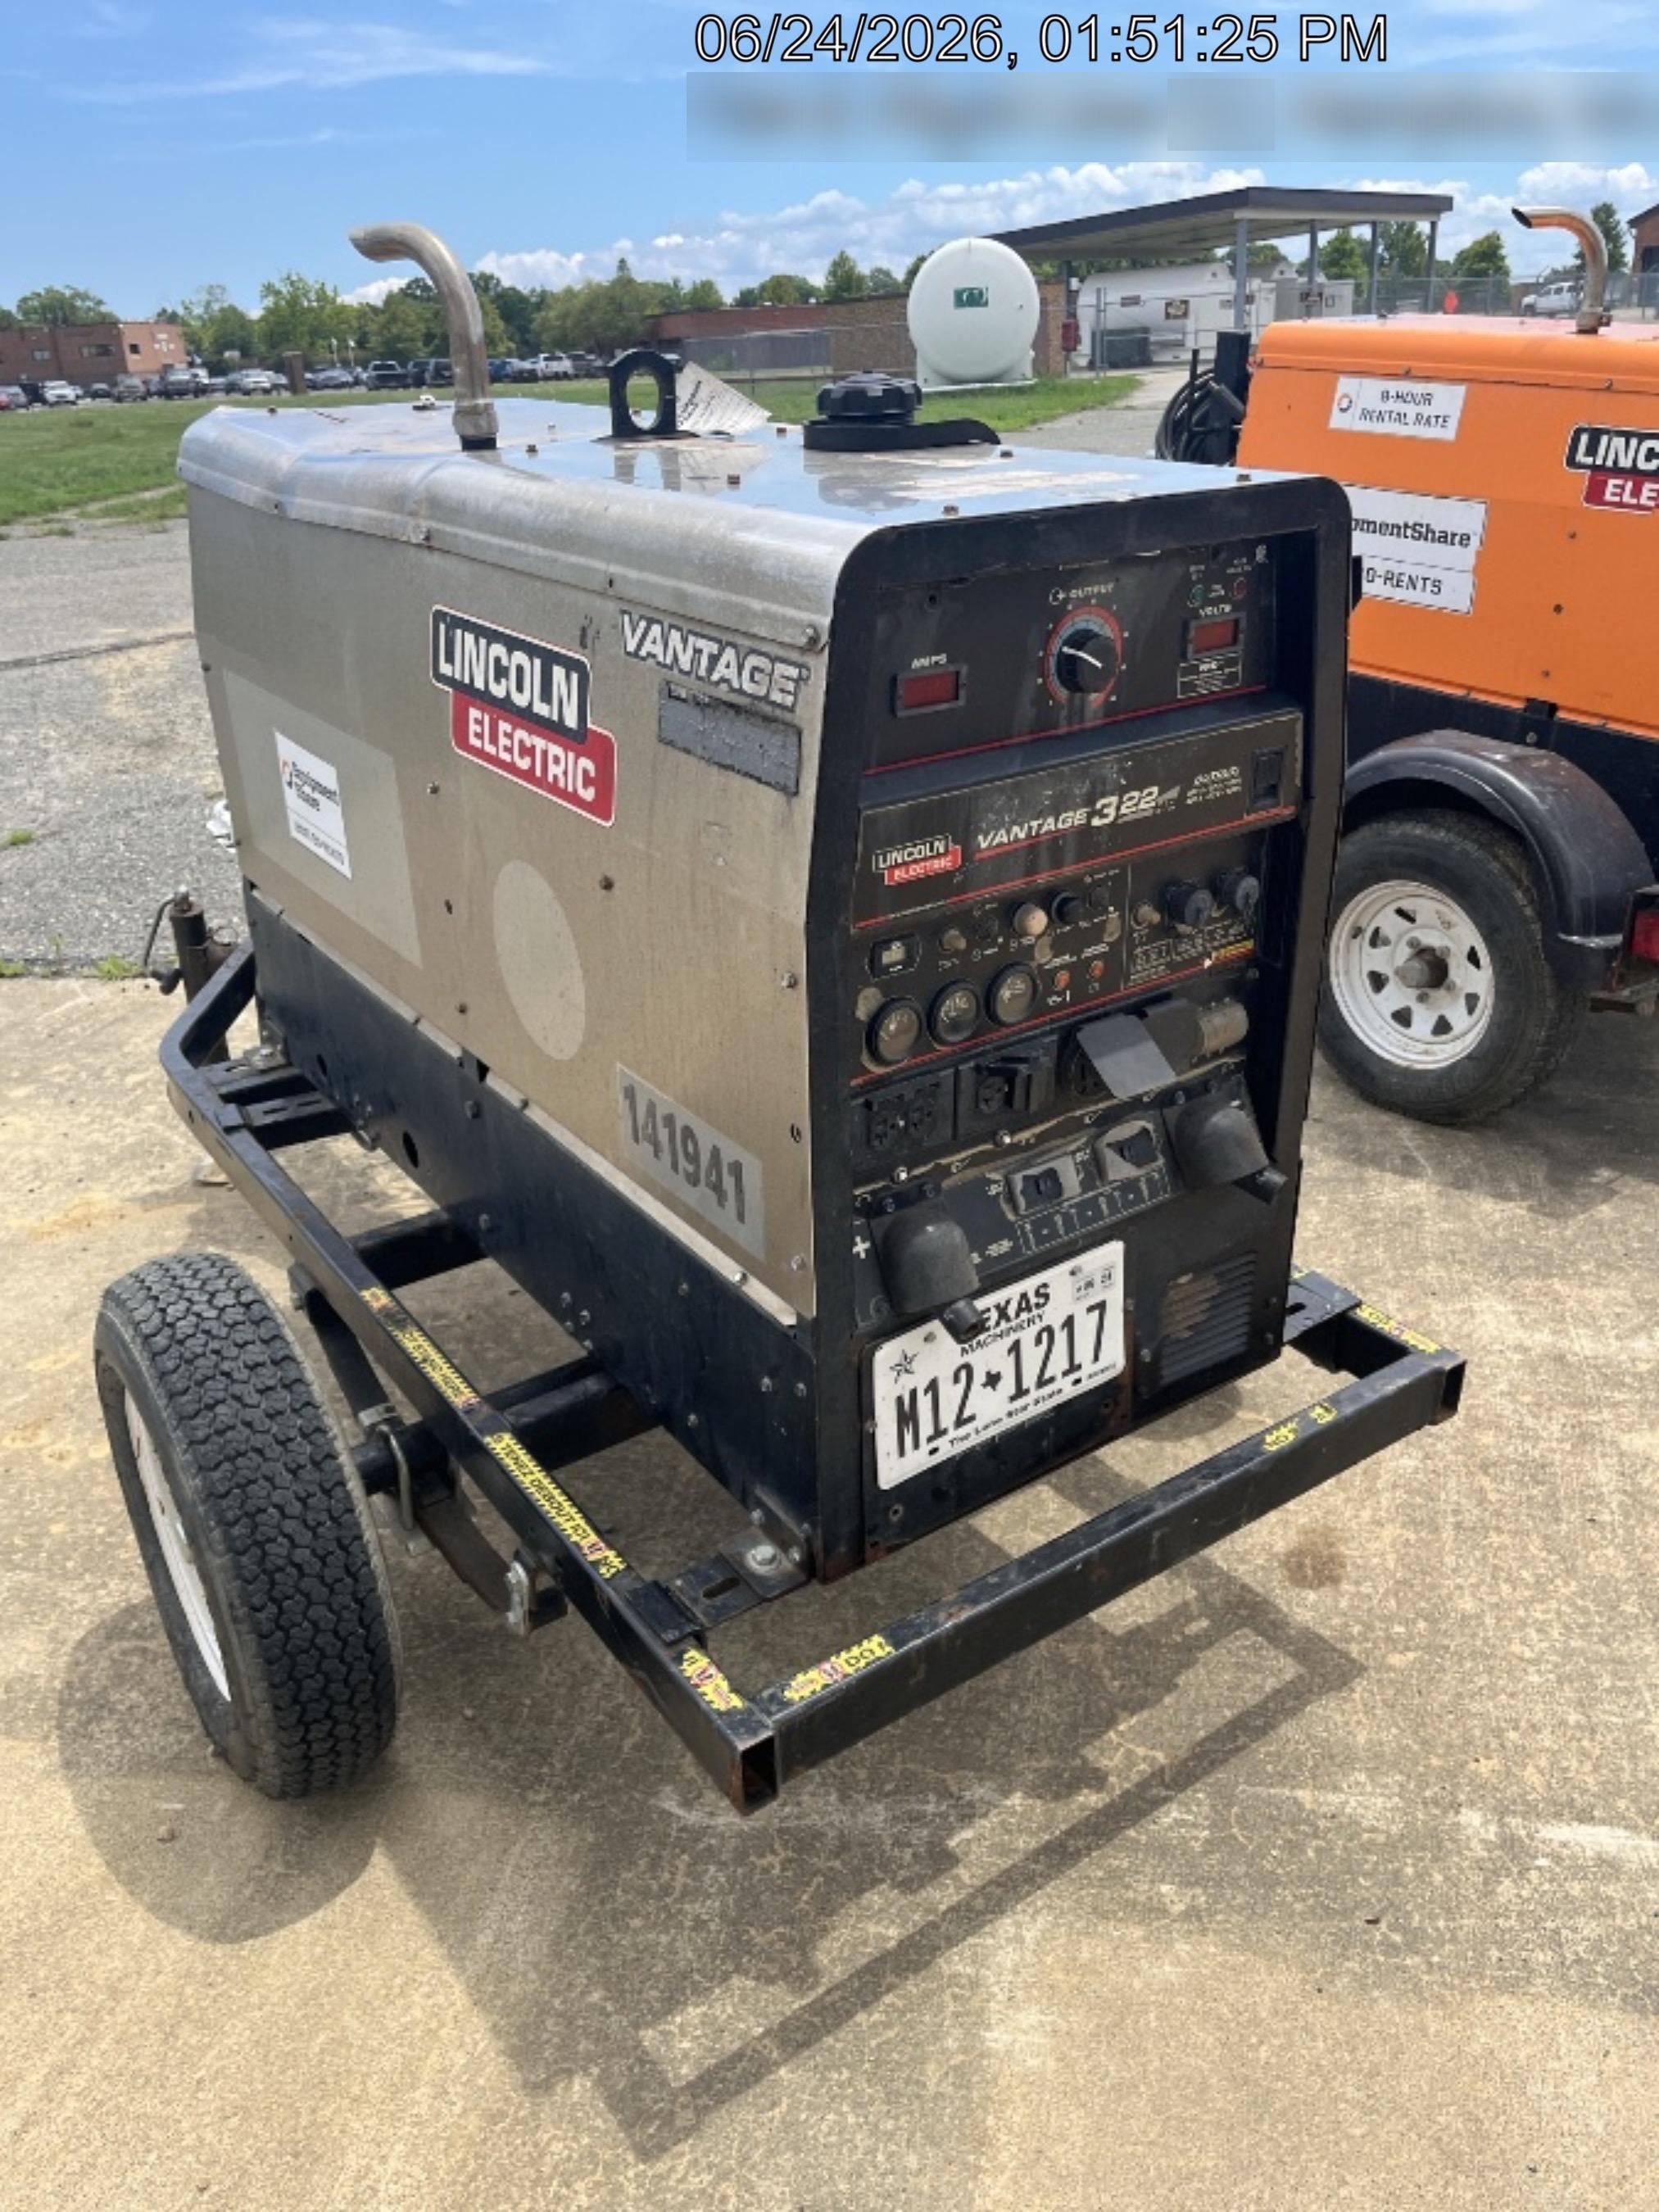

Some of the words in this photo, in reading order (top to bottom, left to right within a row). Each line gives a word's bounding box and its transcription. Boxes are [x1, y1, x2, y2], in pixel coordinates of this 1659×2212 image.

[1358, 408, 1409, 426] RENTAL
[1413, 412, 1452, 428] RATE
[1380, 389, 1434, 406] 8-HOUR
[438, 622, 579, 731] LINCOLN
[622, 612, 802, 709] VANTAGE
[468, 706, 596, 802] ELECTRIC
[977, 808, 1092, 850] VANTAGE
[1090, 786, 1159, 827] 322
[878, 839, 945, 868] LINCOLN
[623, 1083, 746, 1225] 141941
[980, 1283, 1050, 1333] EXAS
